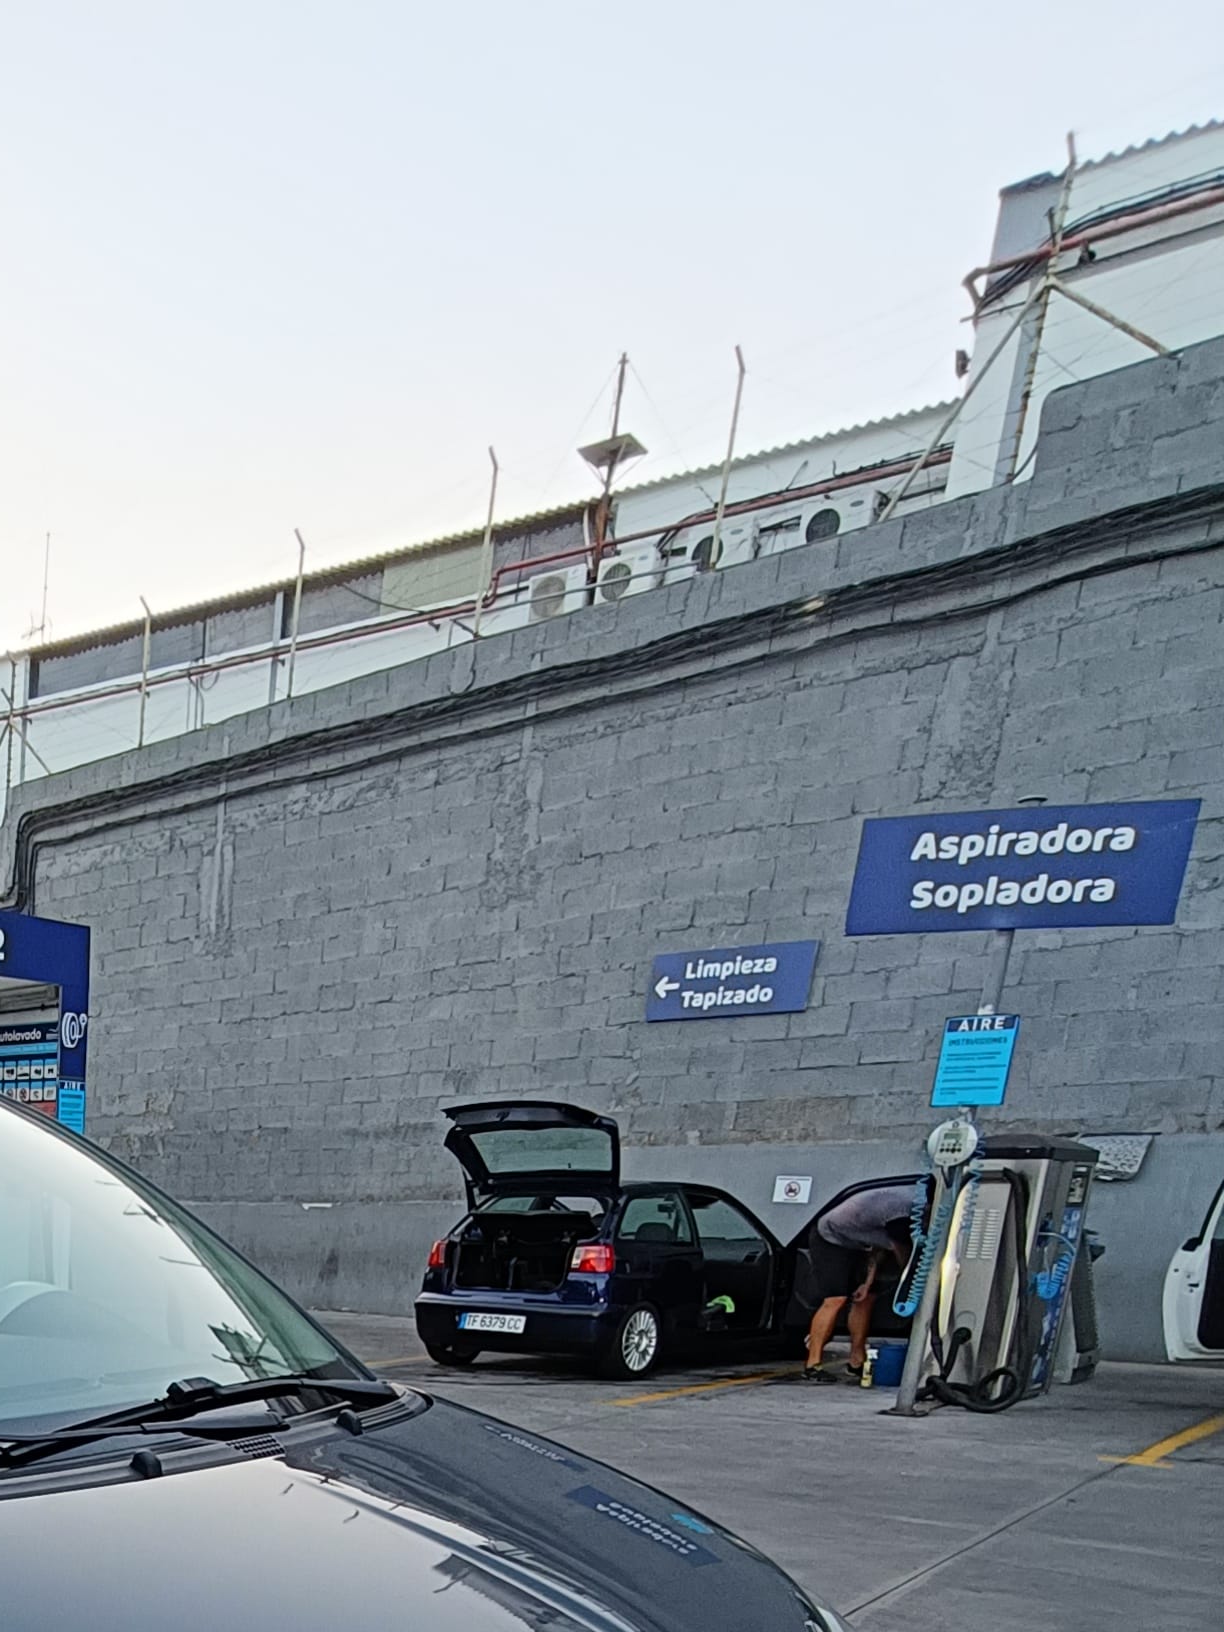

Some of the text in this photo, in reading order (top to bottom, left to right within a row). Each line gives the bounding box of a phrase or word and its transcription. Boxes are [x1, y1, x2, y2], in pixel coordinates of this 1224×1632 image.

[911, 823, 1136, 864] Aspiradora
[910, 873, 1116, 912] Sopladora
[685, 954, 777, 981] Limpieza
[681, 985, 773, 1010] Tapizado
[958, 1016, 1006, 1032] AIRE
[467, 1314, 522, 1330] TF 6379 CC
